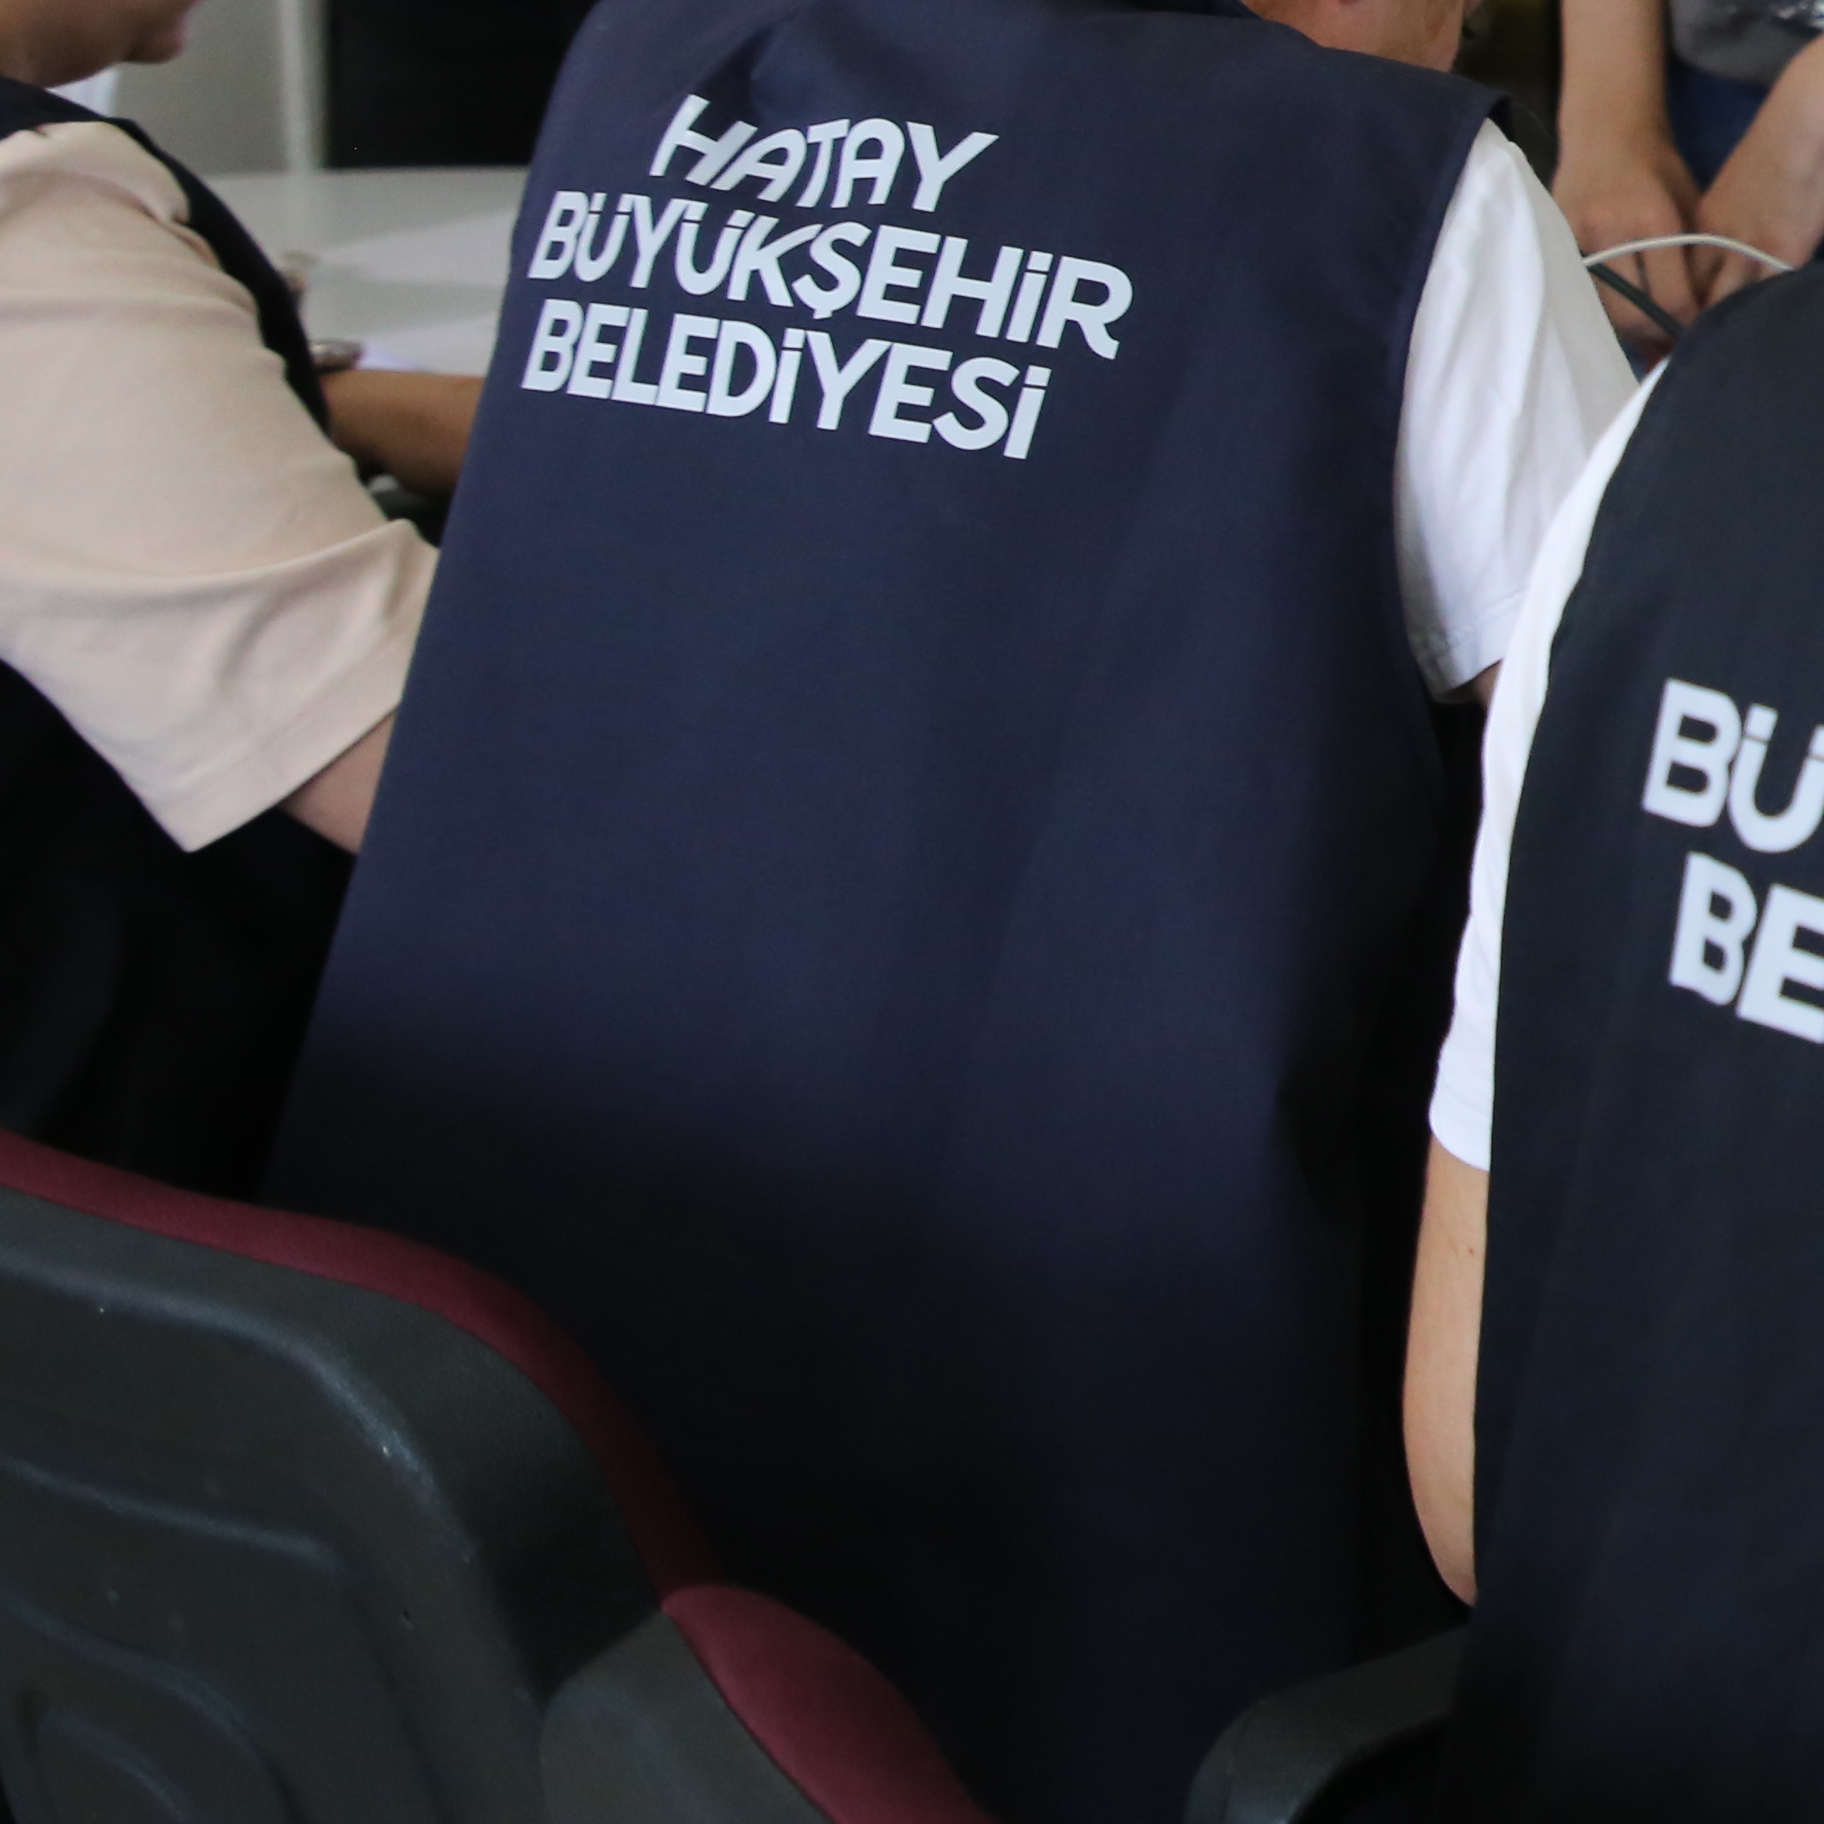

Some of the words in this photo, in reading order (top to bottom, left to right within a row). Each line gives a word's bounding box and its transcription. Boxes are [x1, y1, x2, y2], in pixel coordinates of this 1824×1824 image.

[650, 94, 999, 212] HATAY
[528, 190, 1133, 360] BÜYÜKŞEHİR
[521, 298, 1052, 460] BELEDİYESİ
